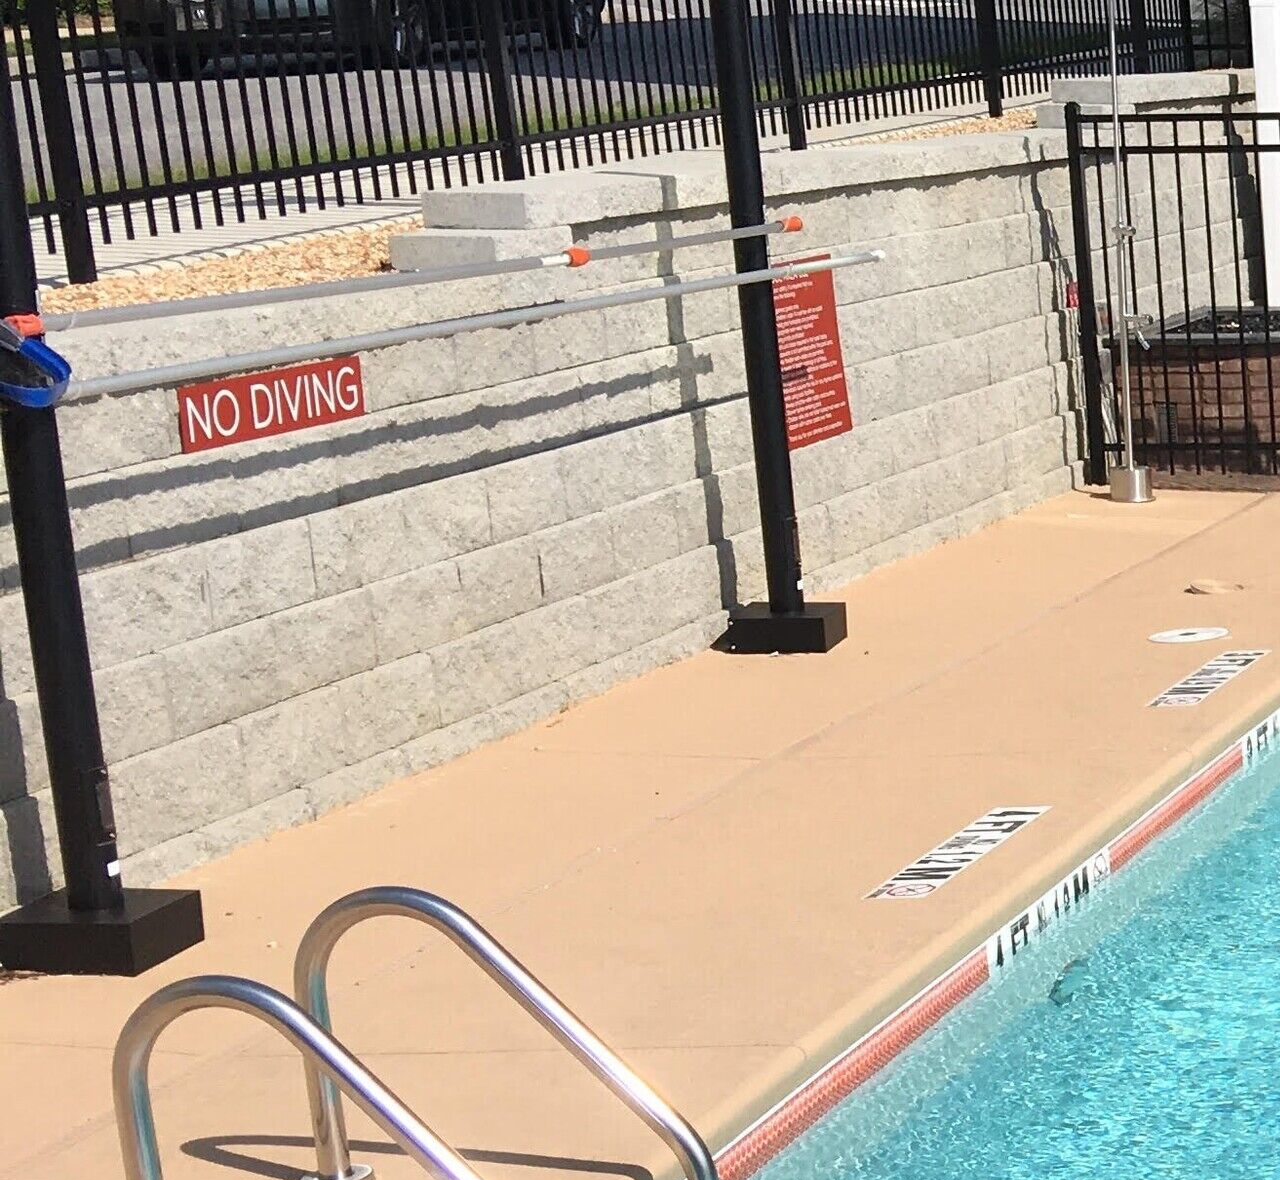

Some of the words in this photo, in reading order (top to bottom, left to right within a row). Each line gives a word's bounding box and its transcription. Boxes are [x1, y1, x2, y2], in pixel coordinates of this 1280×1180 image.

[185, 389, 240, 444] NO
[250, 366, 359, 430] DIVING
[962, 820, 1027, 833] FT
[890, 866, 963, 881] M
[1010, 913, 1029, 956] FT
